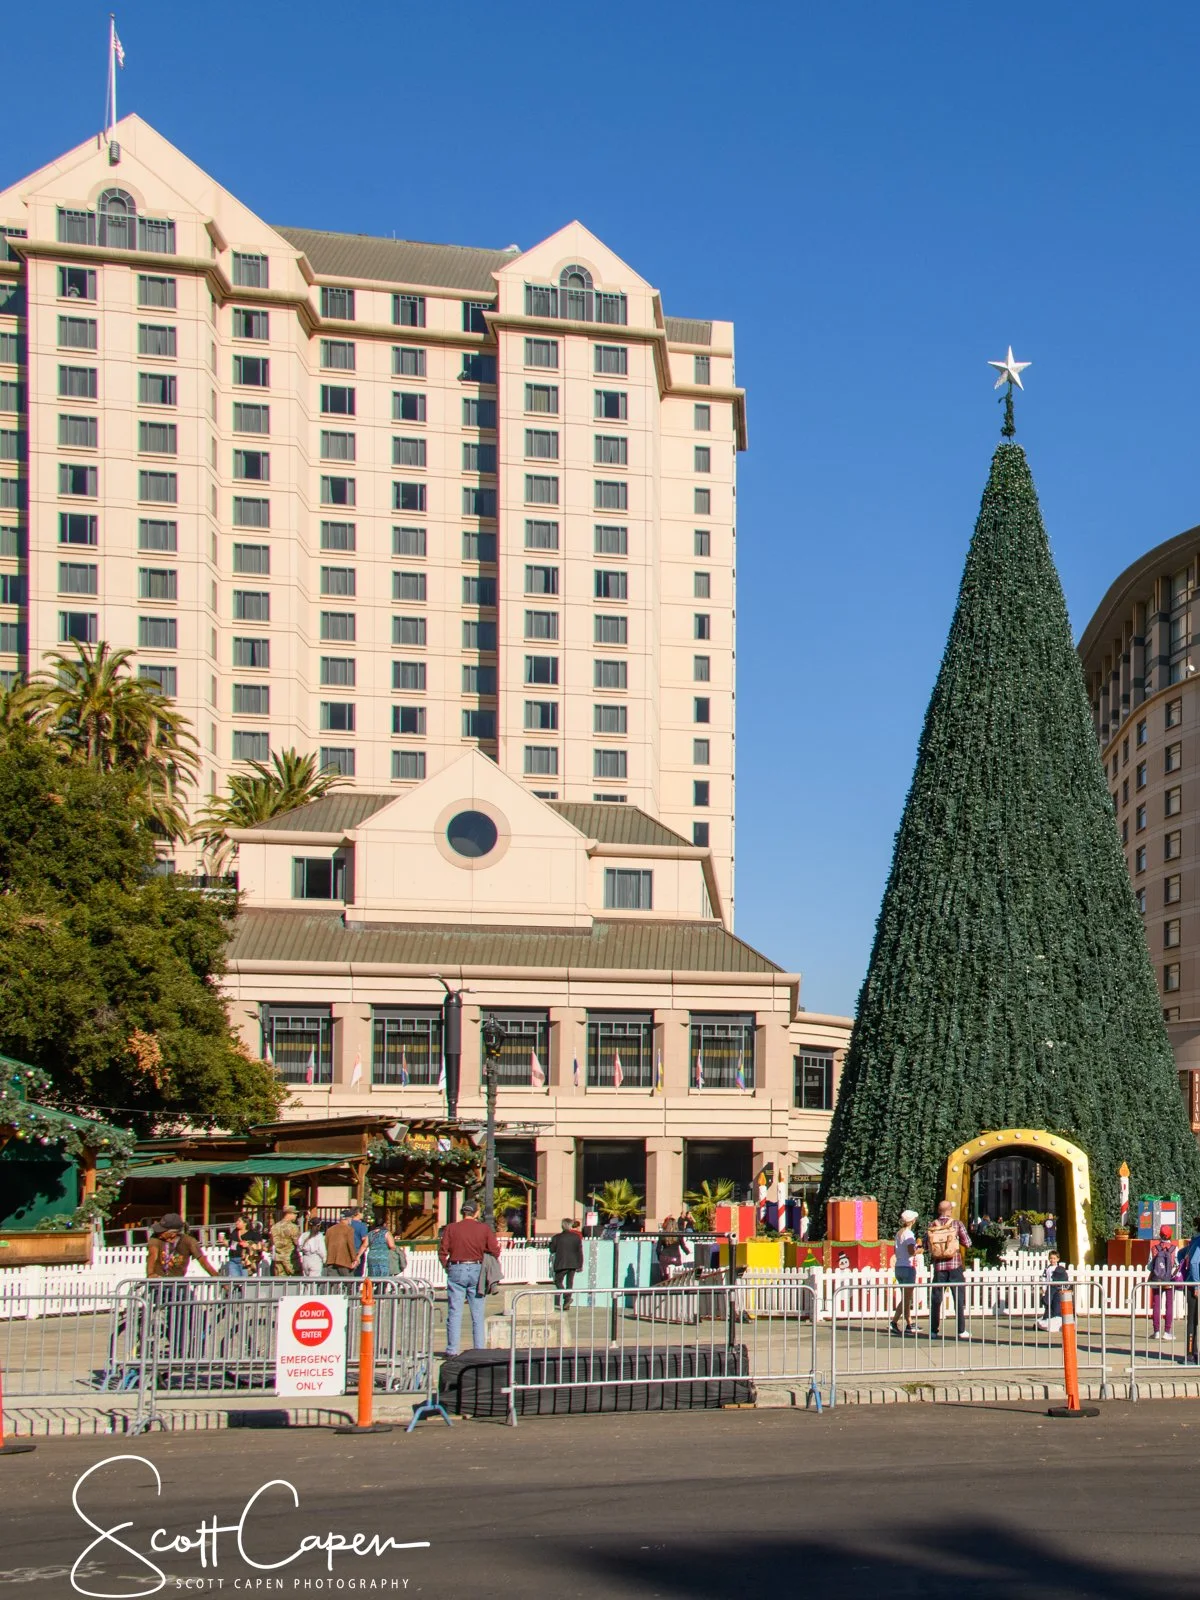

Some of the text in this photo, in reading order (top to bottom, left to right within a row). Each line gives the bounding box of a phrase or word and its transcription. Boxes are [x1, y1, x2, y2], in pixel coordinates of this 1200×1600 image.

[413, 1142, 431, 1150] STAGE
[280, 1355, 341, 1364] EMERGENCY
[287, 1368, 334, 1377] VEHICLES
[296, 1382, 323, 1391] ONLY
